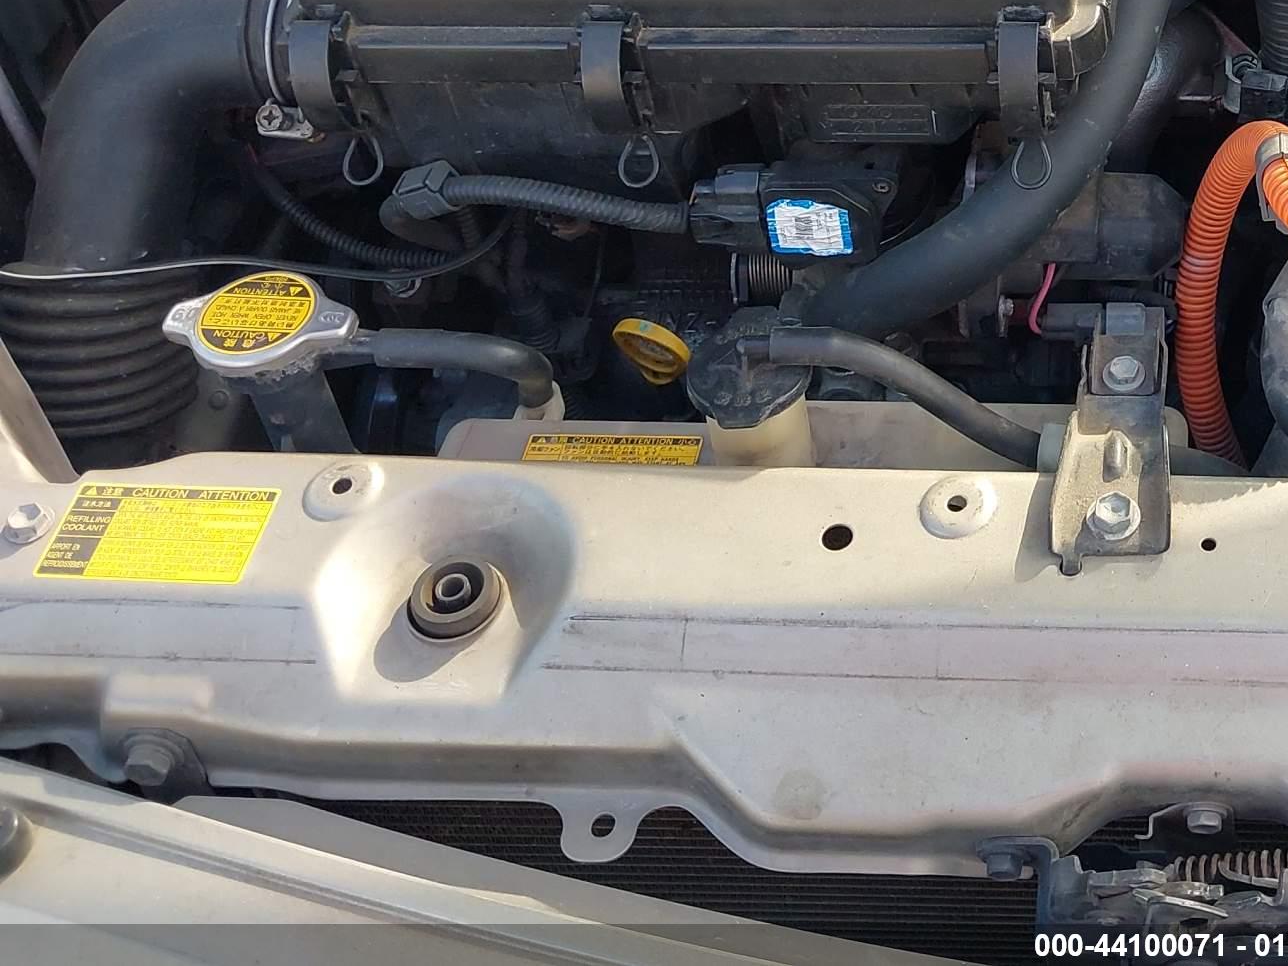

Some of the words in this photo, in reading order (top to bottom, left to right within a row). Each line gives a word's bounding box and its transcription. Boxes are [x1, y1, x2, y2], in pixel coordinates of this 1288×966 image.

[232, 286, 290, 297] ATTENTION
[213, 330, 265, 342] CAUTION
[573, 436, 615, 445] CAUTION
[620, 437, 673, 446] ATTENTION
[132, 488, 189, 499] CAUTION
[197, 490, 271, 501] ATTENTION
[66, 514, 111, 524] REFILLING
[62, 522, 105, 532] COOLANT
